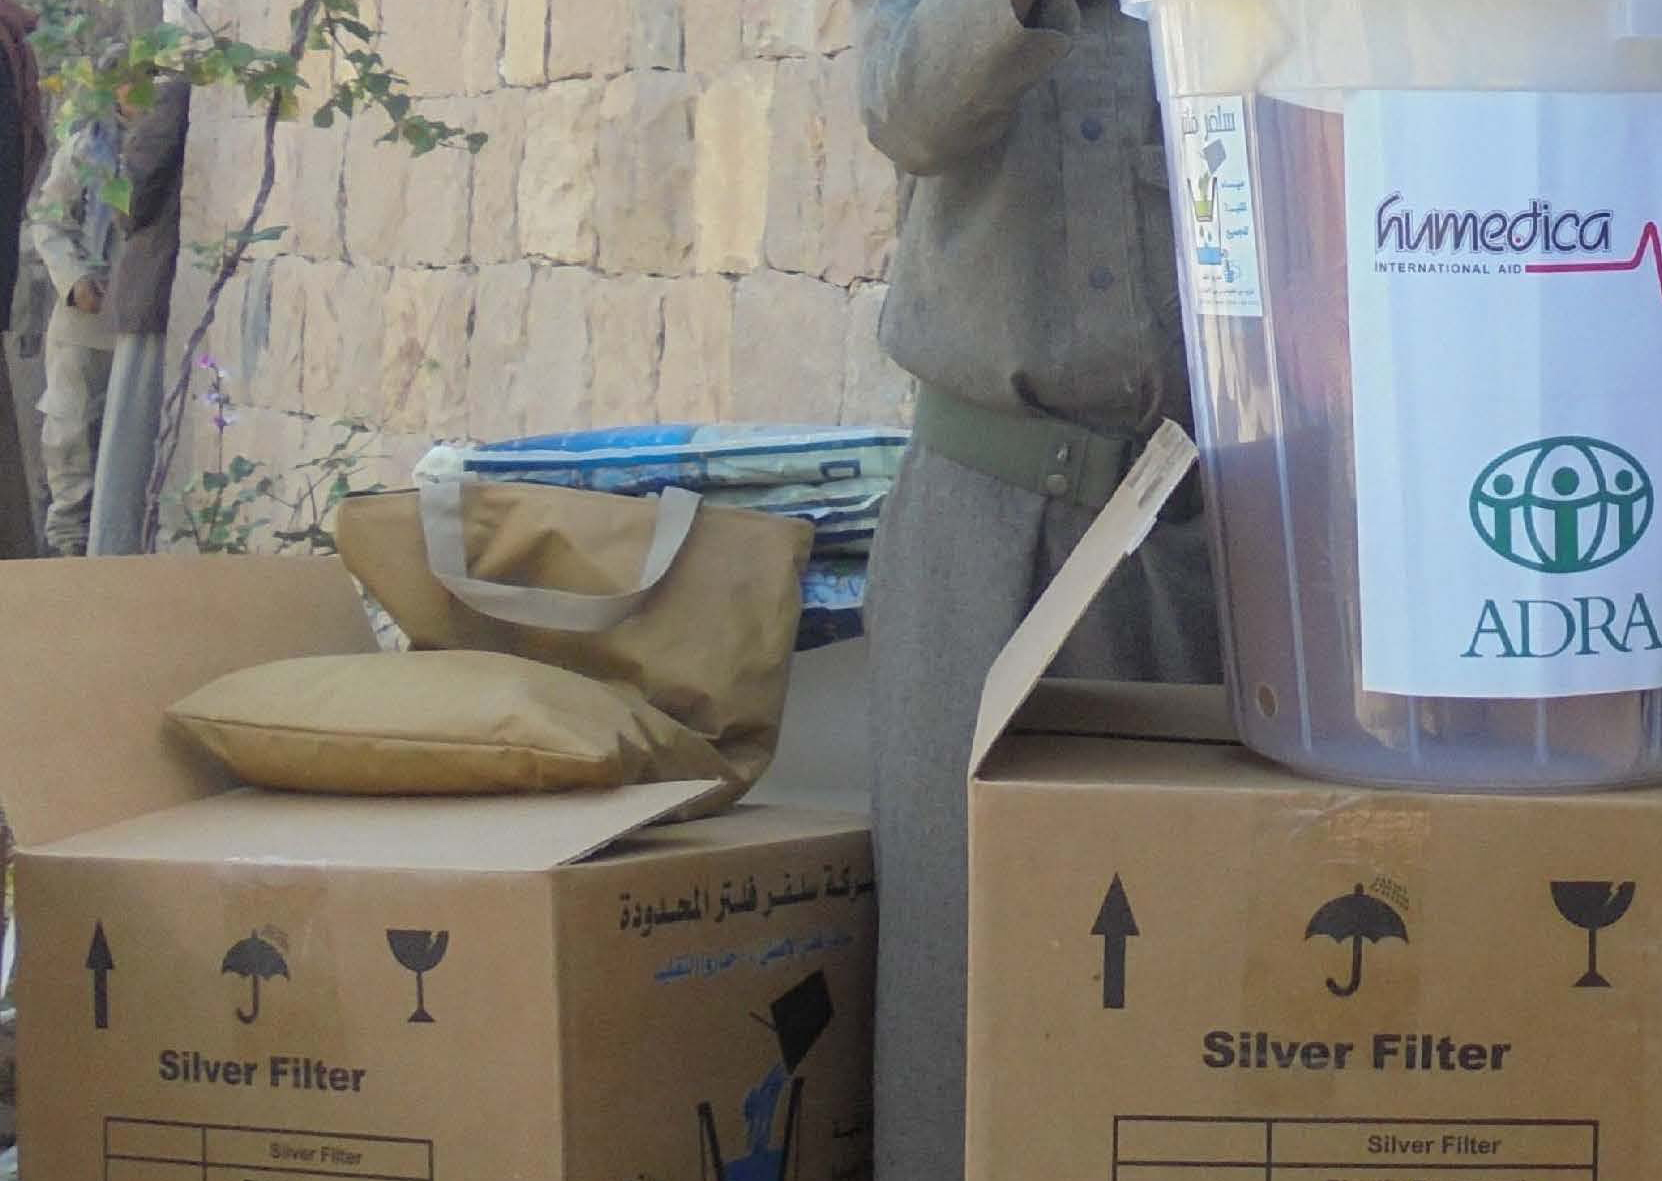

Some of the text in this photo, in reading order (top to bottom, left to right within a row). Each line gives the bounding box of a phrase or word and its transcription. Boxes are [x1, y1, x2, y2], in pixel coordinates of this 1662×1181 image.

[1376, 192, 1612, 254] humedica
[1375, 261, 1522, 275] INTERNATIONAL AID
[1202, 1031, 1512, 1071] Silver Filter
[158, 1050, 366, 1092] Silver Filter
[270, 1142, 363, 1165] Silver Filter
[1367, 1135, 1501, 1156] Silver Filter
